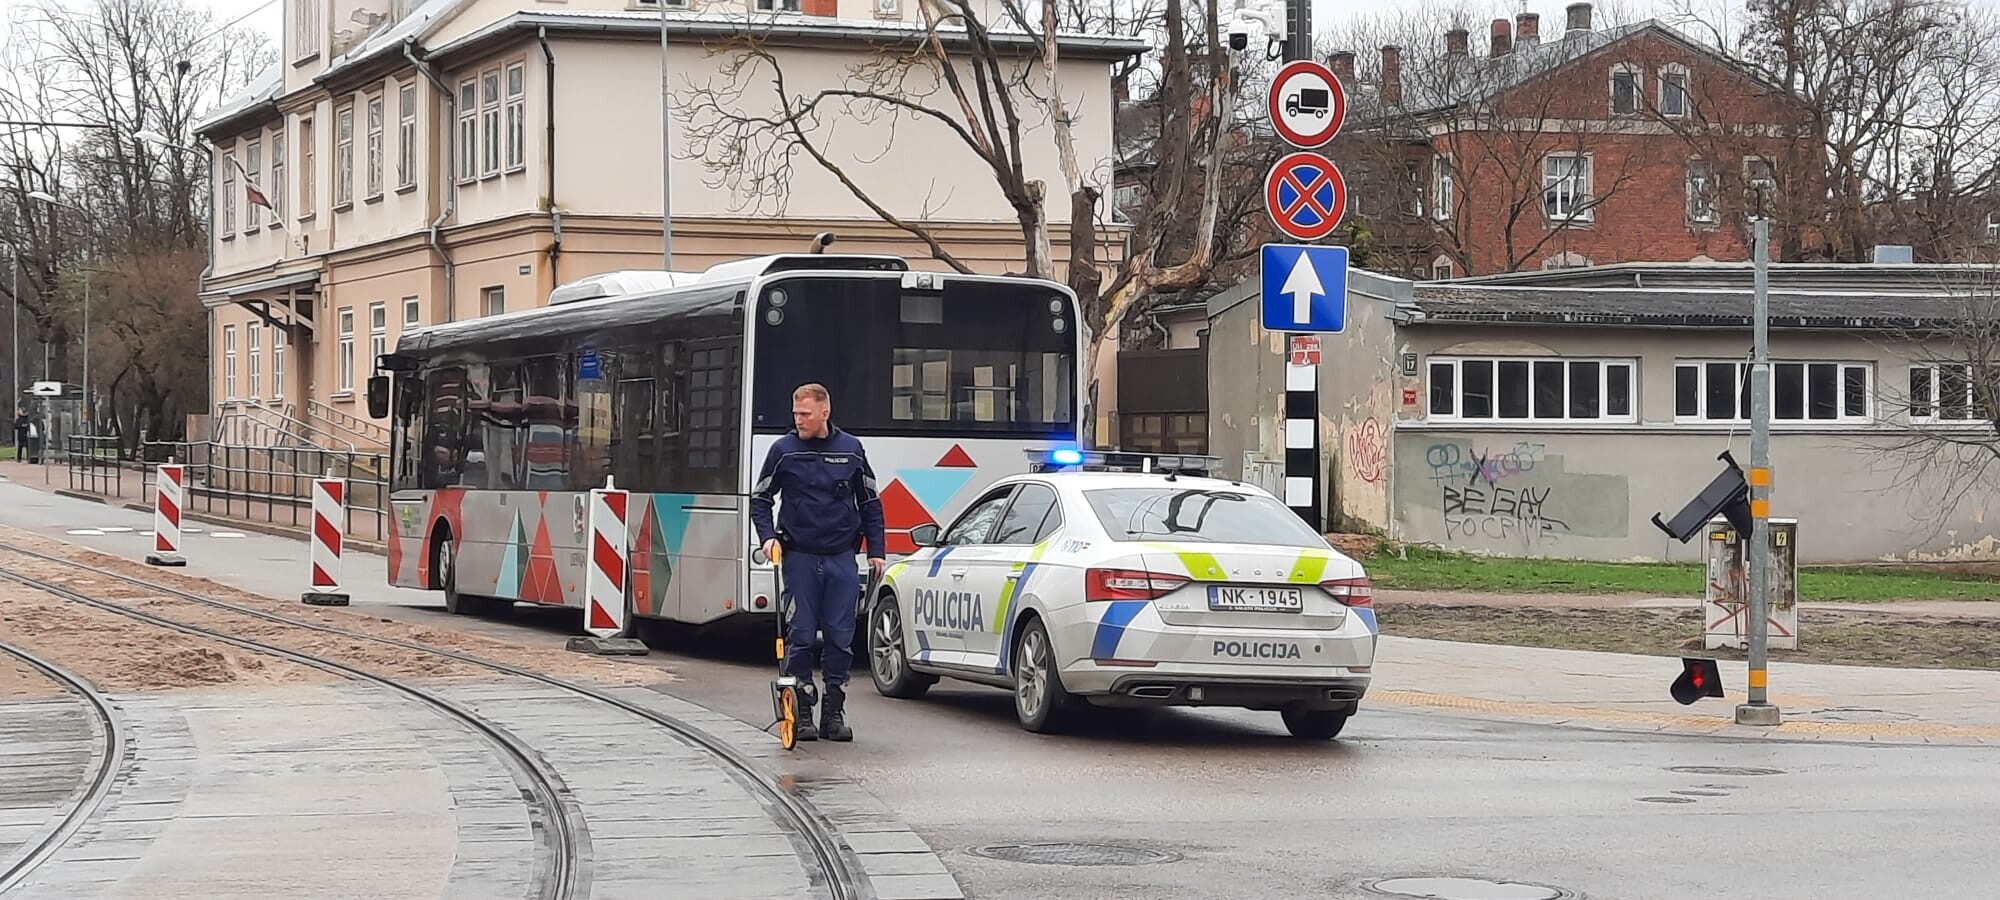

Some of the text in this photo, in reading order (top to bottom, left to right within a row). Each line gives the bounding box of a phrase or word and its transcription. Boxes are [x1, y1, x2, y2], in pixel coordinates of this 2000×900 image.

[1406, 360, 1415, 370] 17
[1444, 486, 1551, 519] BE GAY
[914, 588, 985, 632] POLICIJA
[1213, 641, 1301, 659] POLICIJA
